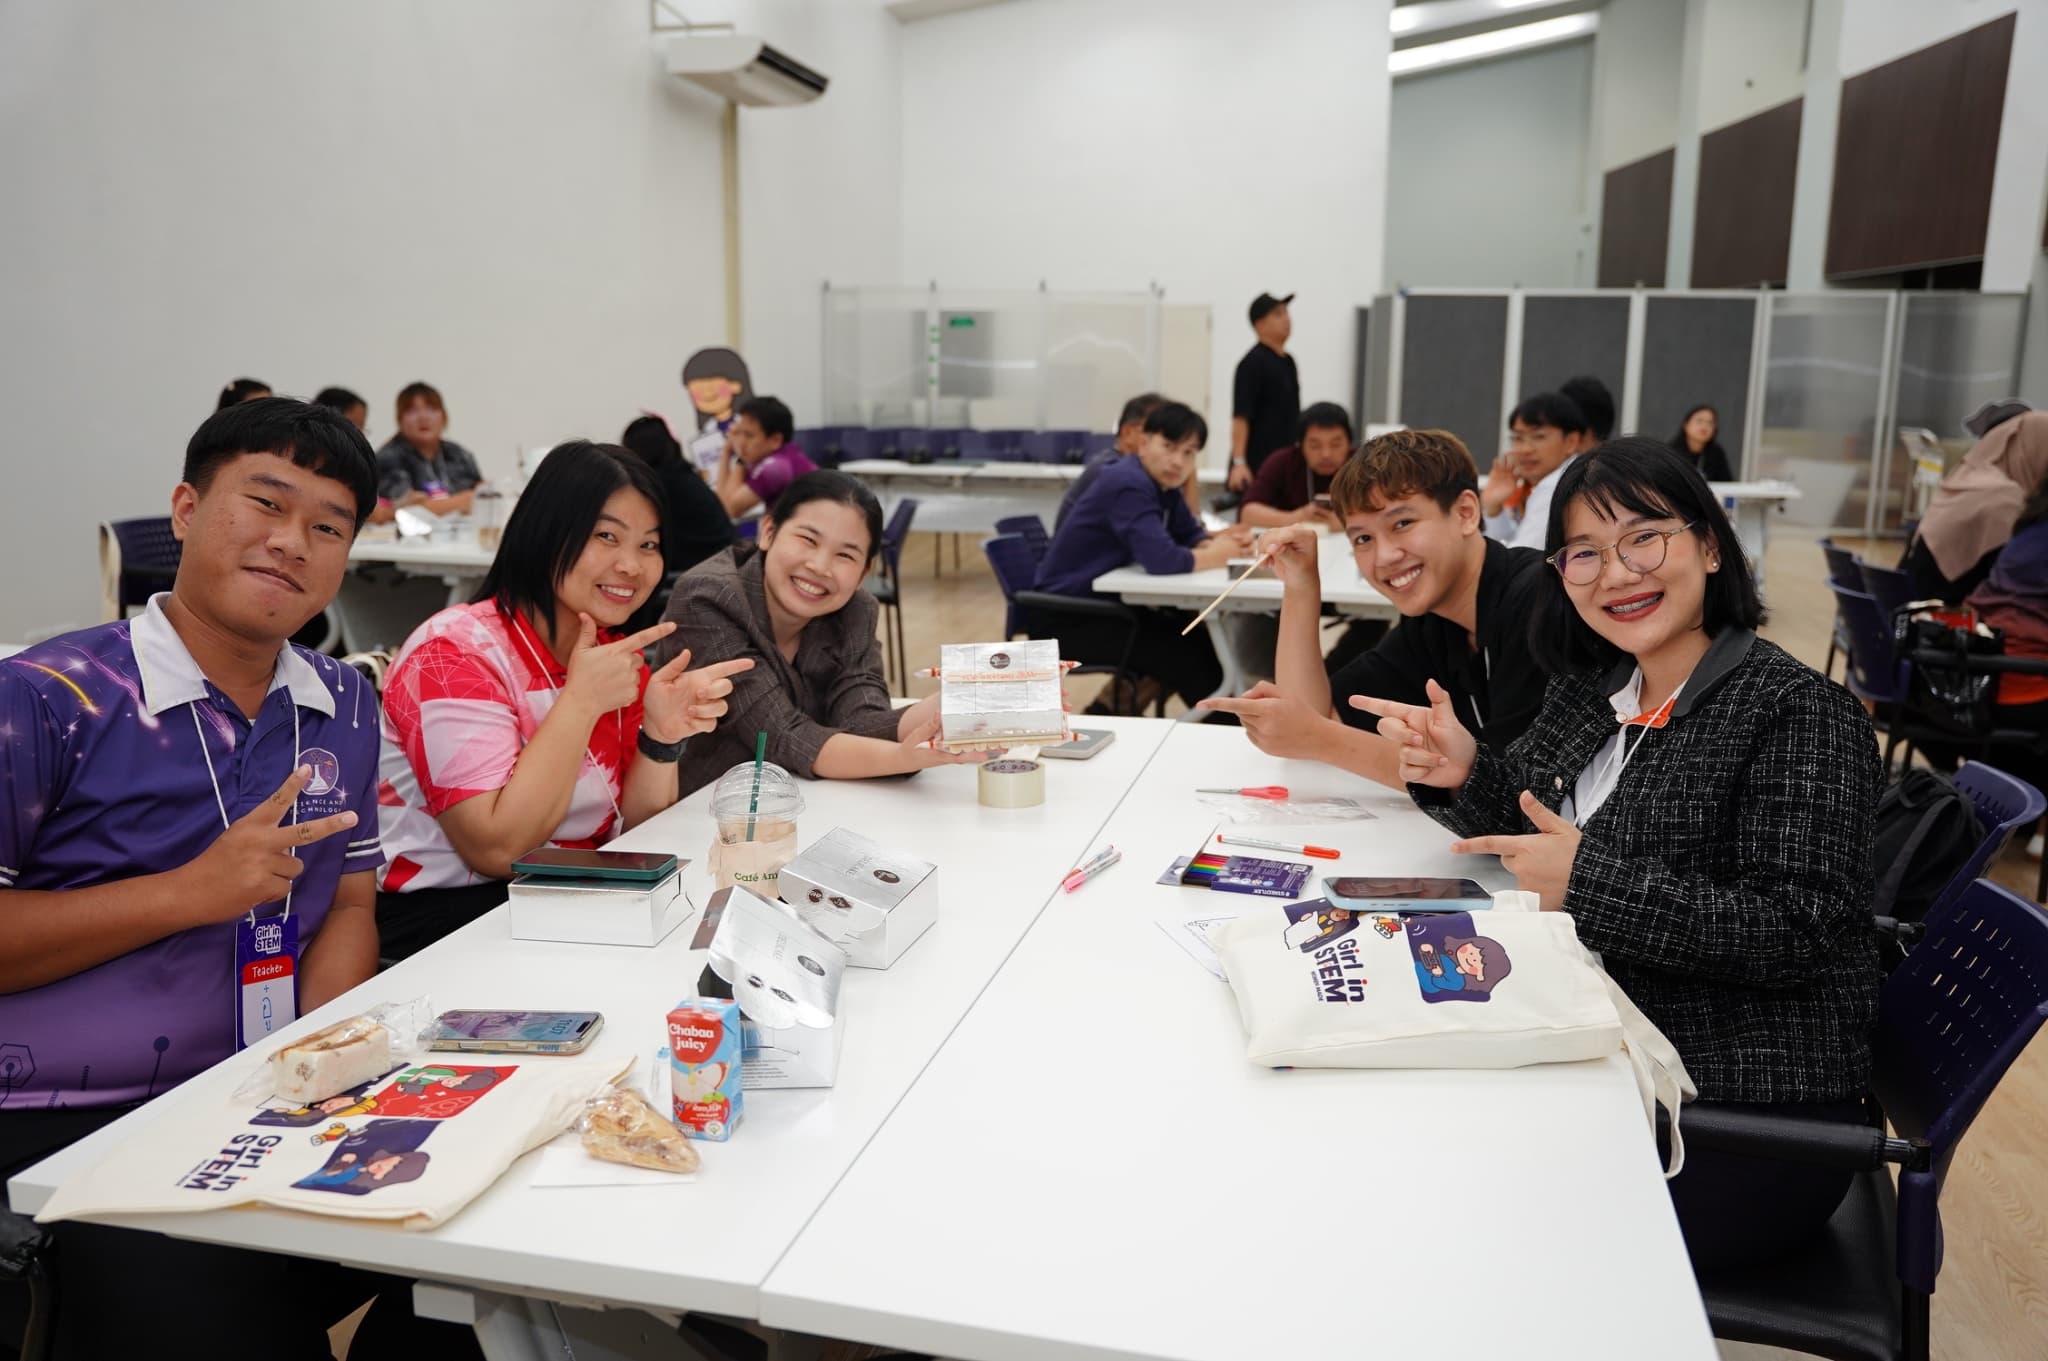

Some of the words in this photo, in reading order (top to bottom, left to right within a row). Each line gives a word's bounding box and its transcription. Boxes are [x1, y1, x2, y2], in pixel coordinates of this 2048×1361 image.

[734, 872, 759, 882] Café
[256, 925, 271, 938] Girl
[272, 924, 281, 936] in
[256, 936, 280, 951] STEM
[1337, 939, 1364, 969] Girl
[252, 964, 283, 978] Teacher
[1314, 947, 1348, 1002] STEM
[1347, 978, 1368, 1002] in
[669, 1023, 715, 1038] Chabaa
[675, 1037, 707, 1053] juicy
[237, 1135, 283, 1169] Girl
[183, 1134, 259, 1190] STEM
[211, 1175, 248, 1191] in
